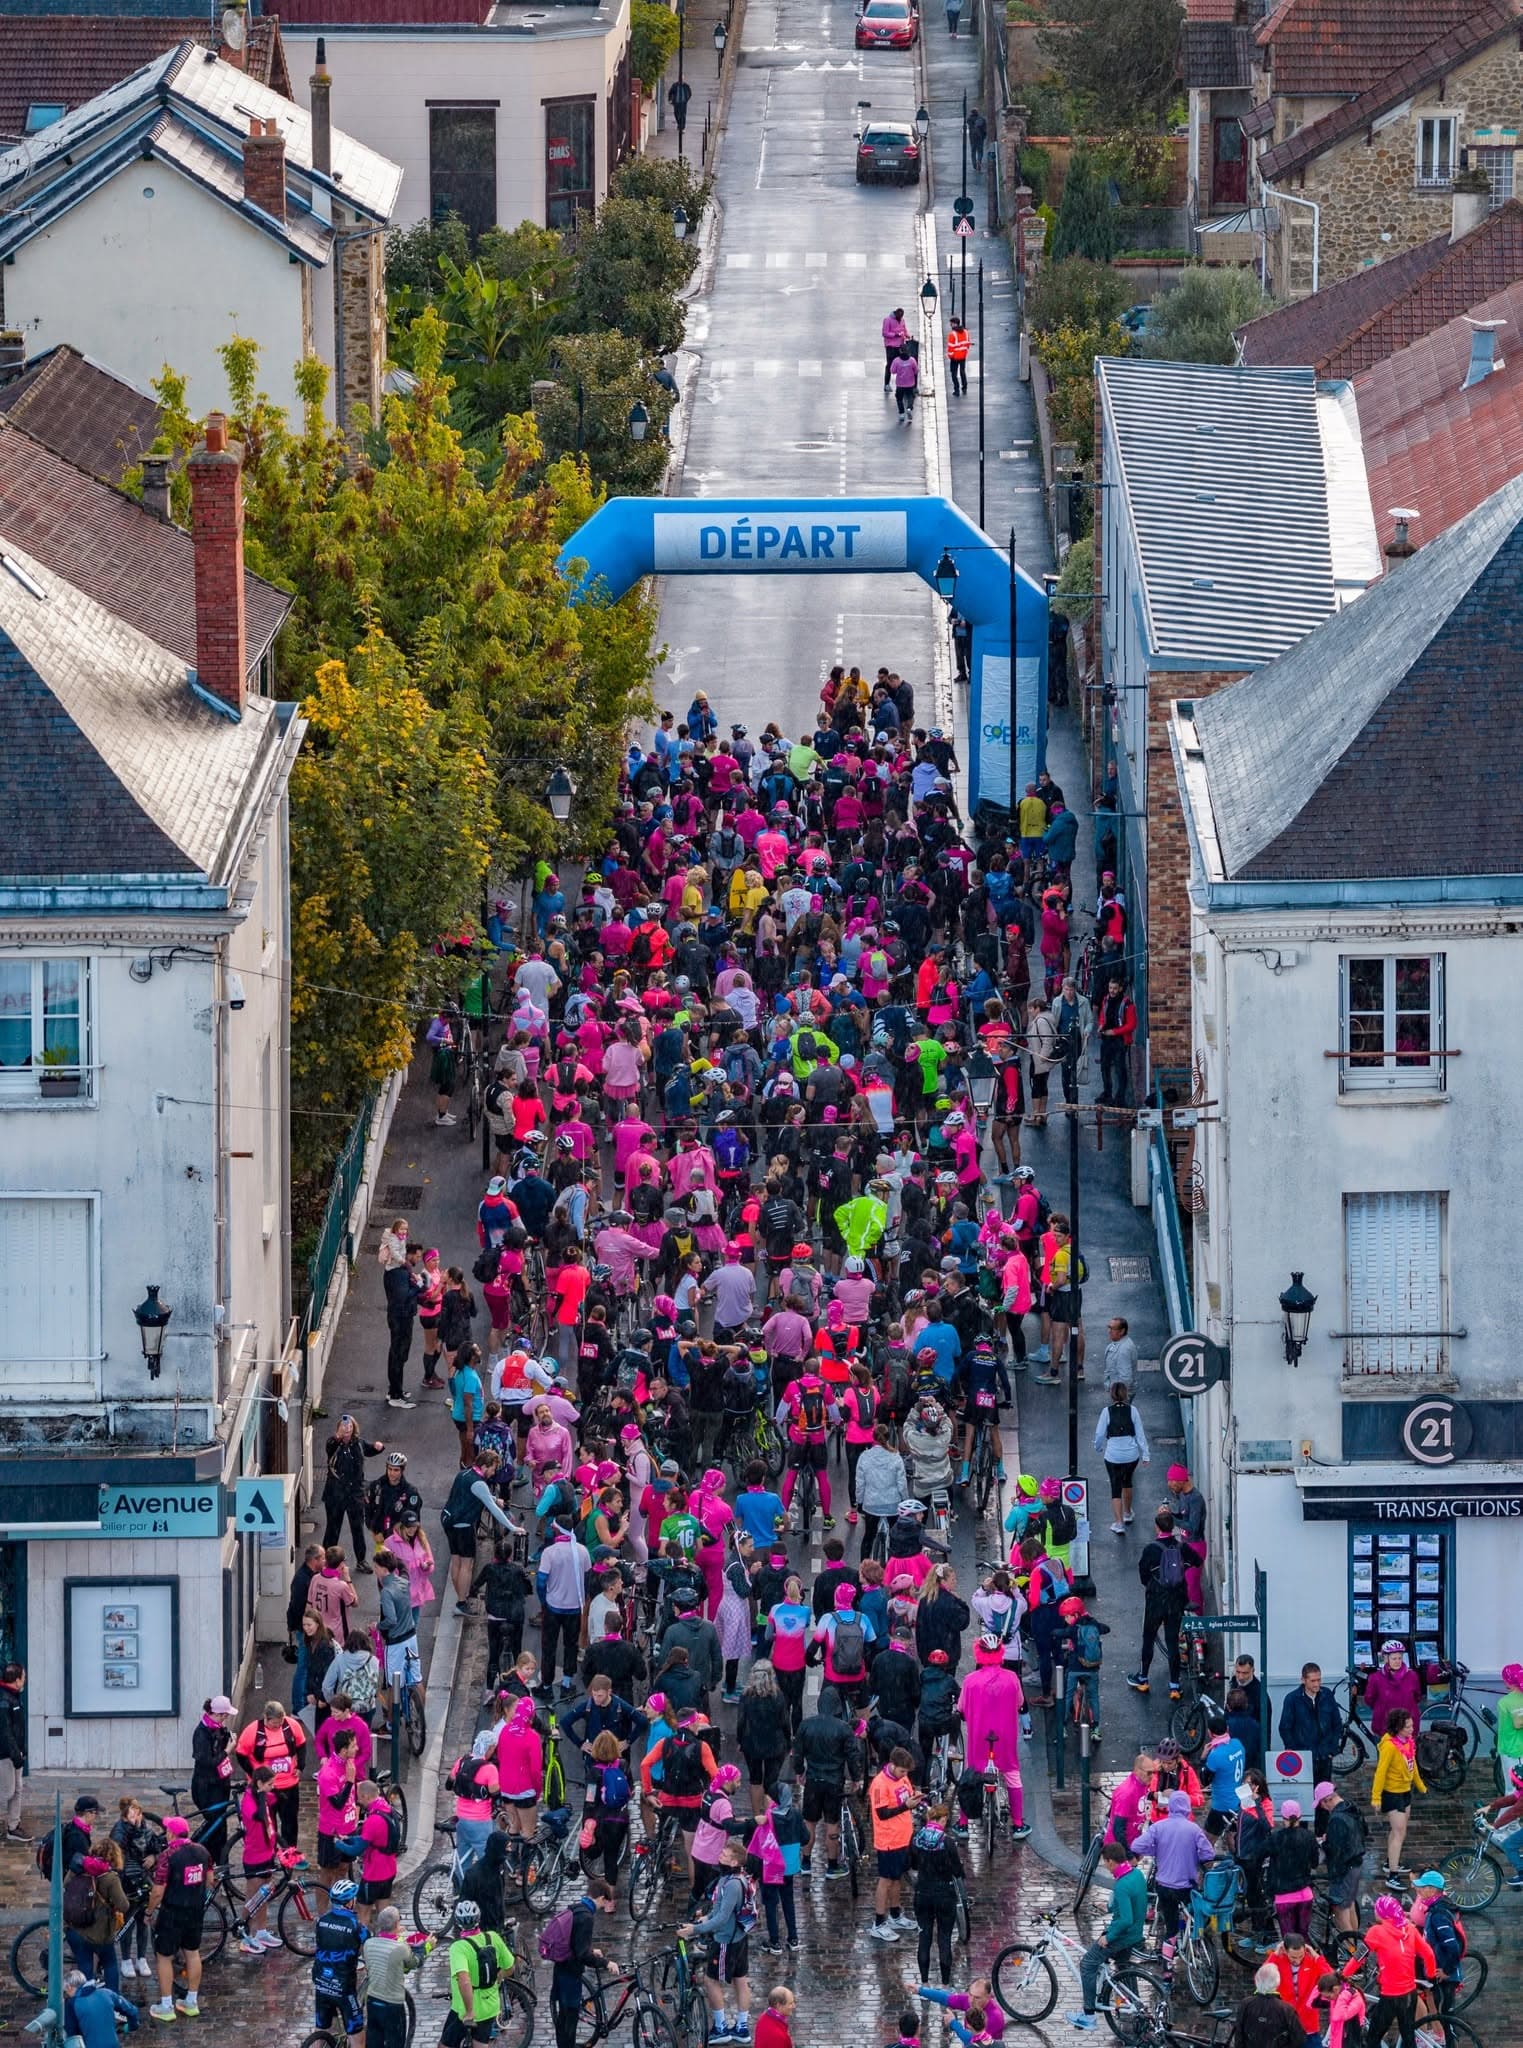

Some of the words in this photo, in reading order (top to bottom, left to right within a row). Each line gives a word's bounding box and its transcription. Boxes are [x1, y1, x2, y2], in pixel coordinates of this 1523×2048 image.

[700, 517, 861, 559] DÉPART
[114, 1494, 213, 1514] Avenue
[1374, 1500, 1521, 1518] TRANSACTIONS
[129, 1524, 147, 1533] par
[677, 1529, 695, 1548] 16
[315, 1592, 329, 1612] 51
